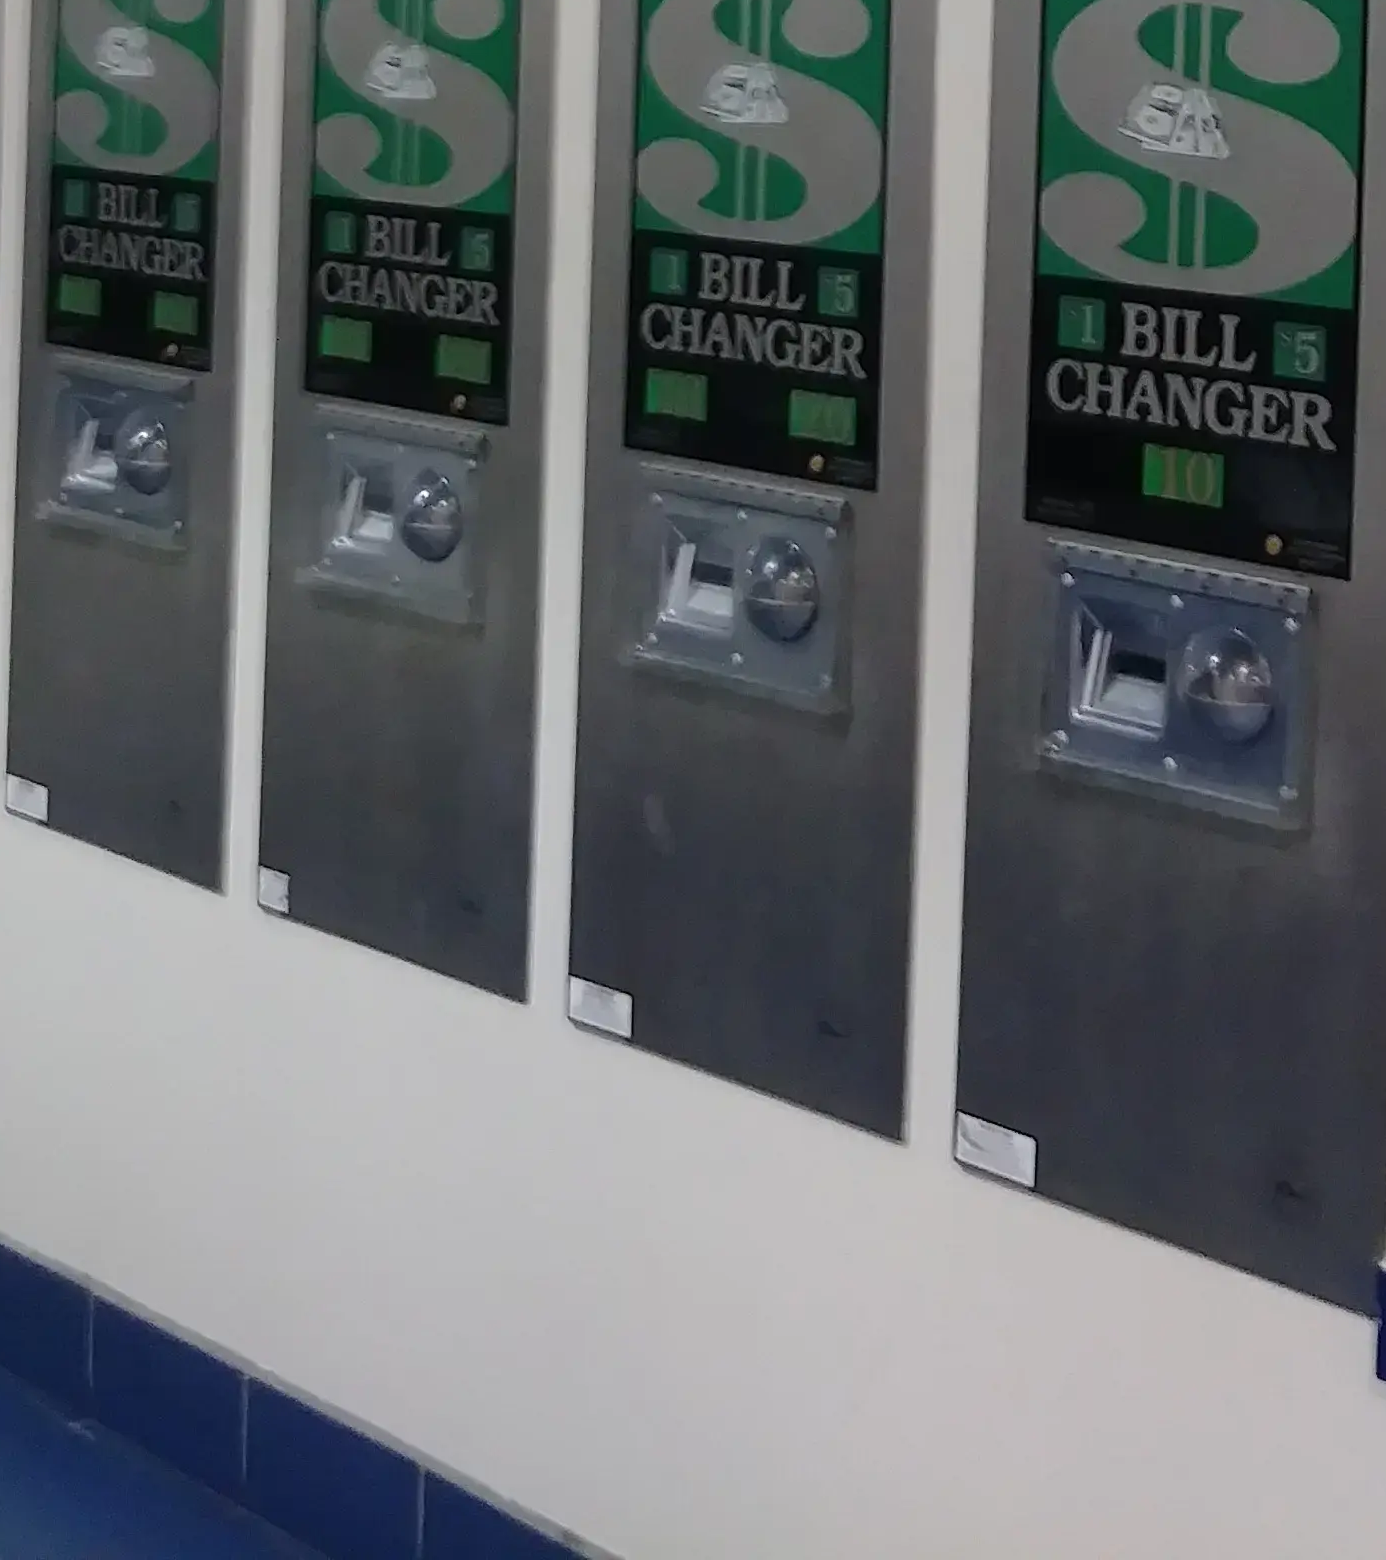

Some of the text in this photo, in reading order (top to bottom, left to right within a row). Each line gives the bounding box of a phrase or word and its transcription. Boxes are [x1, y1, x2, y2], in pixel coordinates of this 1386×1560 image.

[98, 182, 167, 228] BILL
[59, 225, 208, 281] CHANGER
[365, 214, 453, 266] BILL
[318, 261, 501, 325] CHANGER
[699, 252, 806, 311] BILL
[641, 303, 868, 379] CHANGER
[1120, 301, 1257, 372] BILL
[1046, 358, 1337, 453] CHANGER
